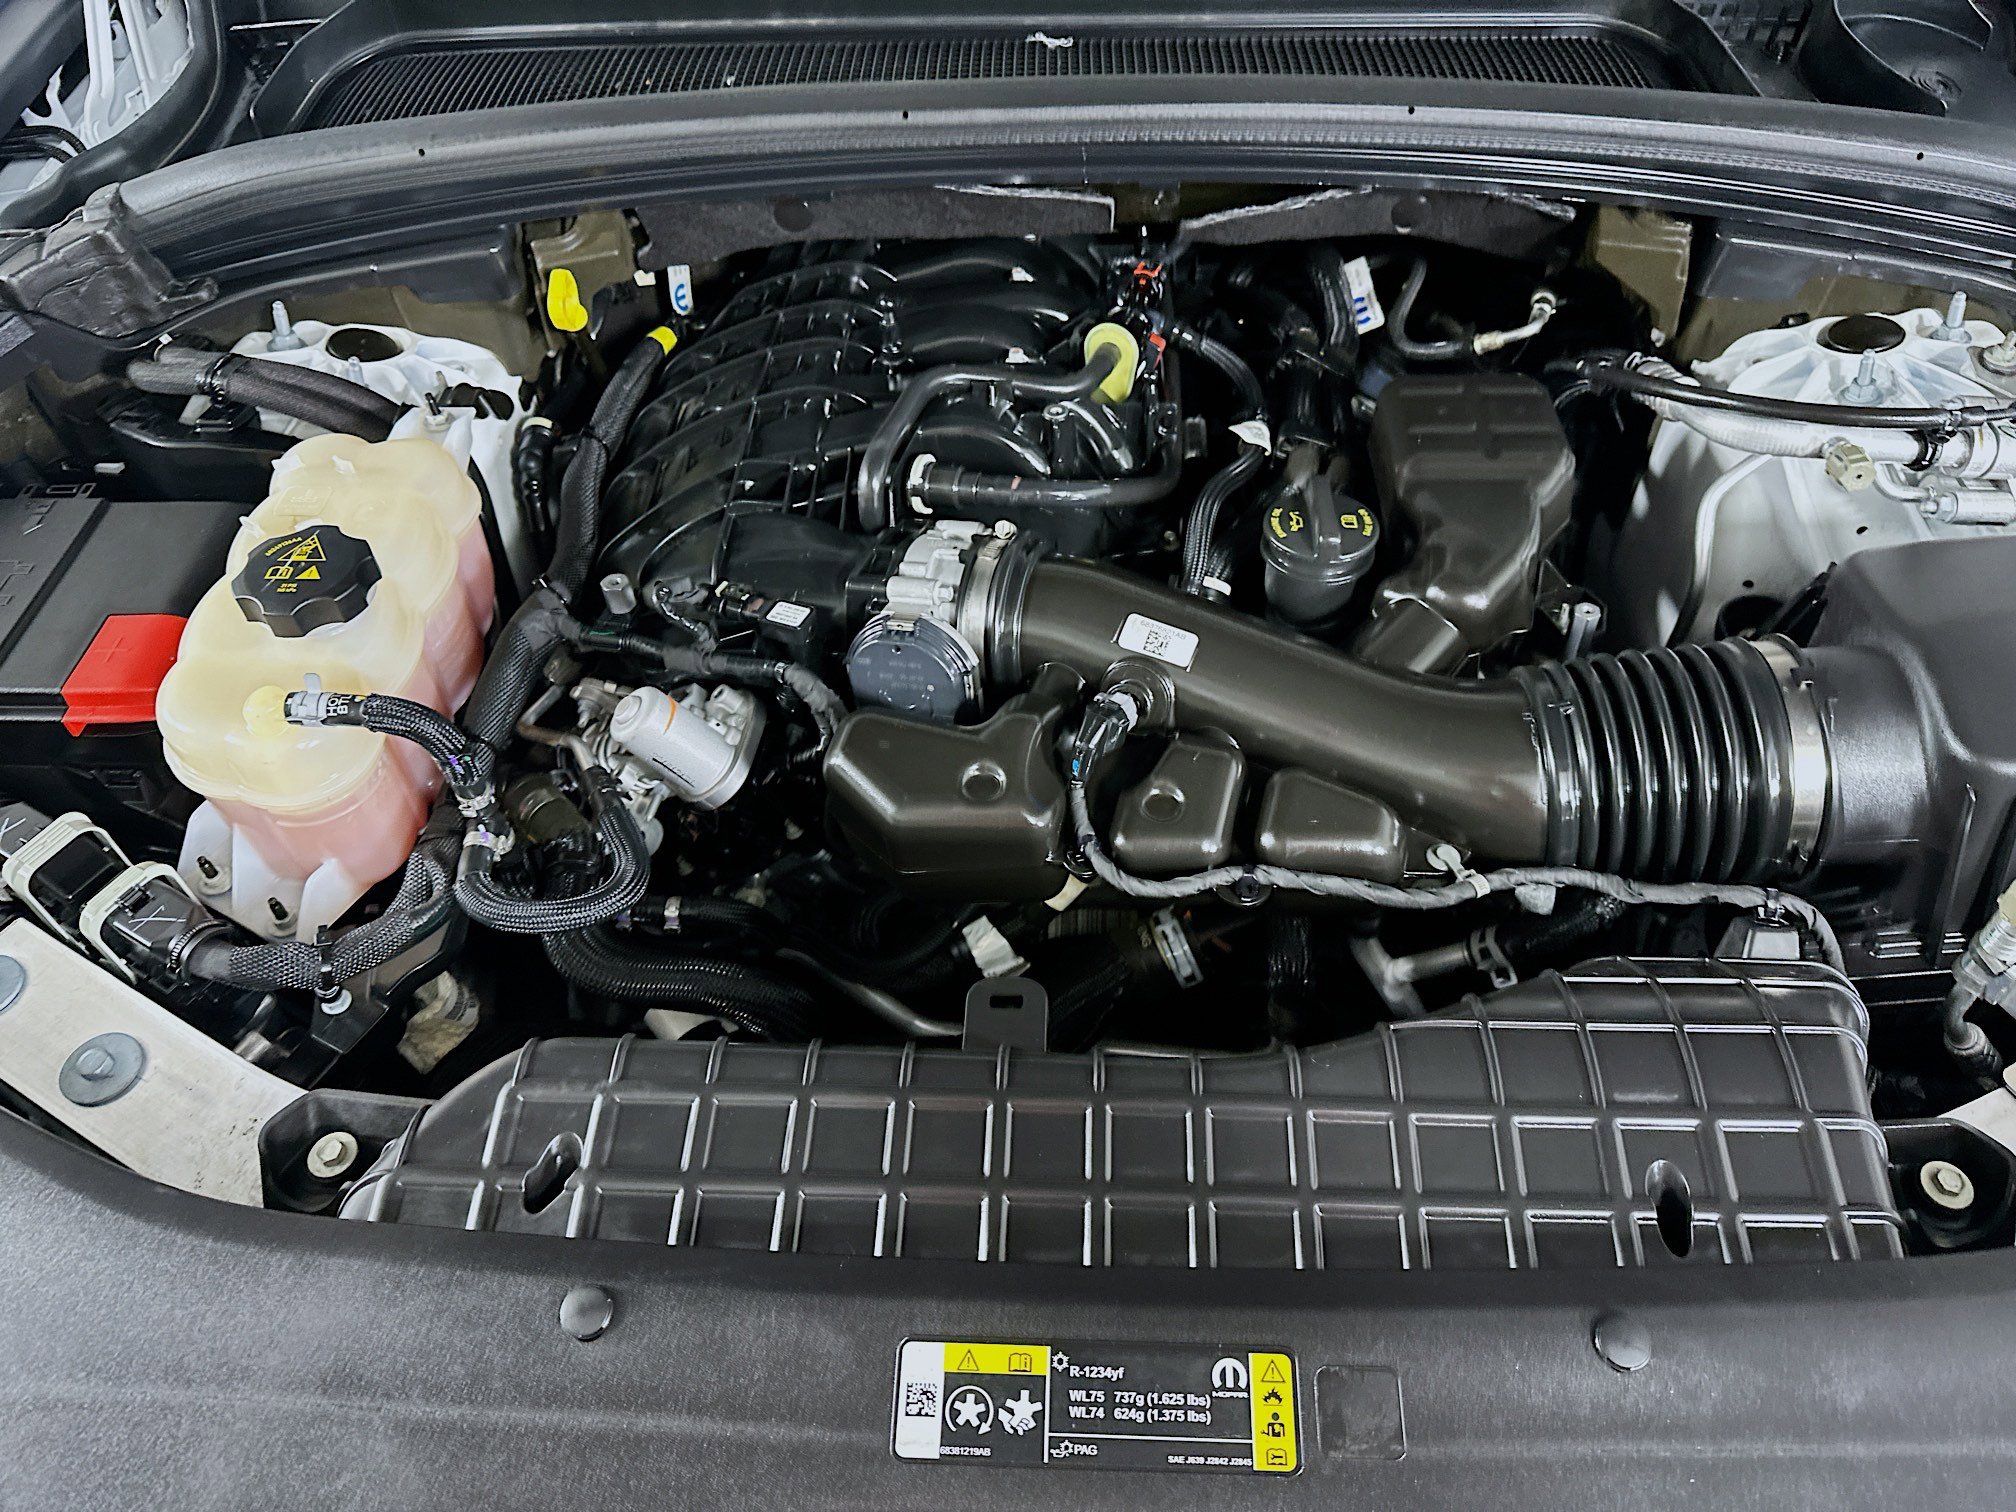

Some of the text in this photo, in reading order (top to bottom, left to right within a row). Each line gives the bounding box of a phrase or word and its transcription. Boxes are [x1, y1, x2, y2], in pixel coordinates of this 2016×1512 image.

[1069, 1365, 1125, 1382] R-1234yf
[1068, 1389, 1212, 1409] WL75 737g (1.625 lbs)
[1211, 1390, 1249, 1399] MOPAR
[1068, 1405, 1212, 1426] WL74 624g (1.375 lbs)
[939, 1446, 991, 1457] 68381219AB
[1073, 1444, 1098, 1456] PAG
[1167, 1455, 1186, 1464] SAE
[1185, 1456, 1205, 1465] J639
